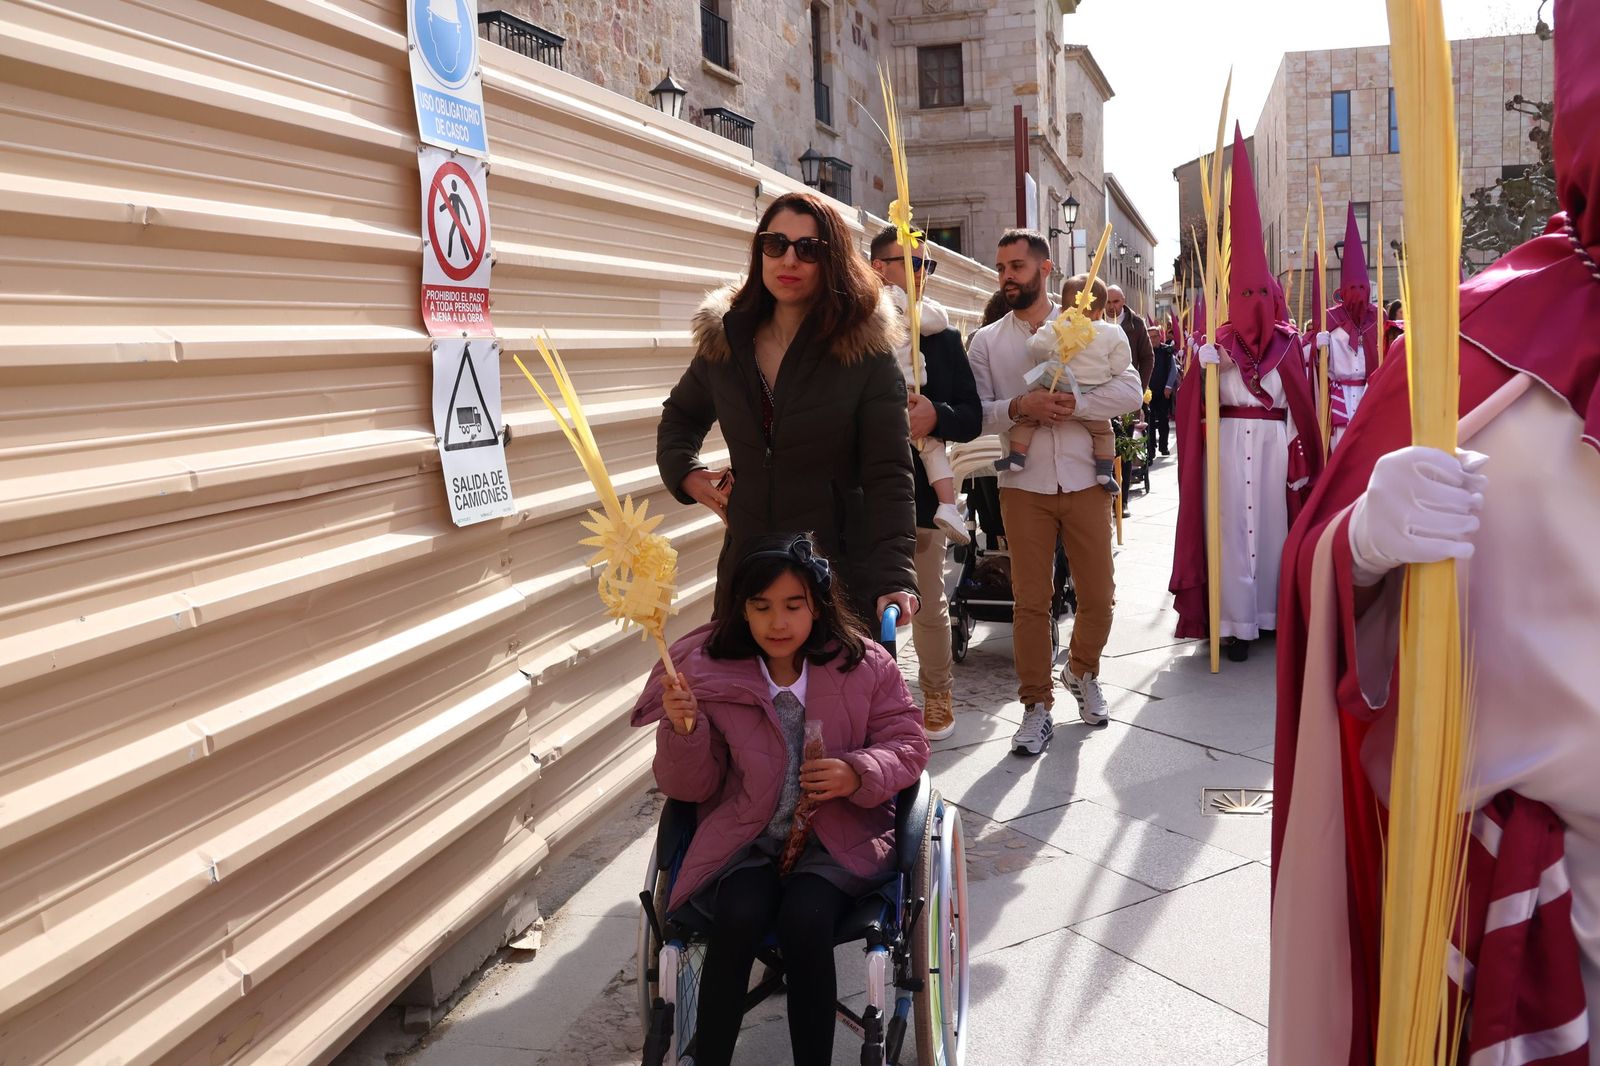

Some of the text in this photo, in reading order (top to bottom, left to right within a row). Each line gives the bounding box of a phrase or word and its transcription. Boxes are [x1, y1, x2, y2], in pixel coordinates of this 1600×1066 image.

[420, 92, 480, 126] USO OBLIGATORIO
[435, 117, 469, 142] DE CASCO
[426, 290, 485, 303] PROHIBIDO EL PASO
[430, 301, 483, 313] A TODA PERSONA
[431, 311, 484, 323] AJENA A LA OBRA
[452, 470, 504, 494] SALIDA DE
[455, 486, 508, 511] CAMIONES
